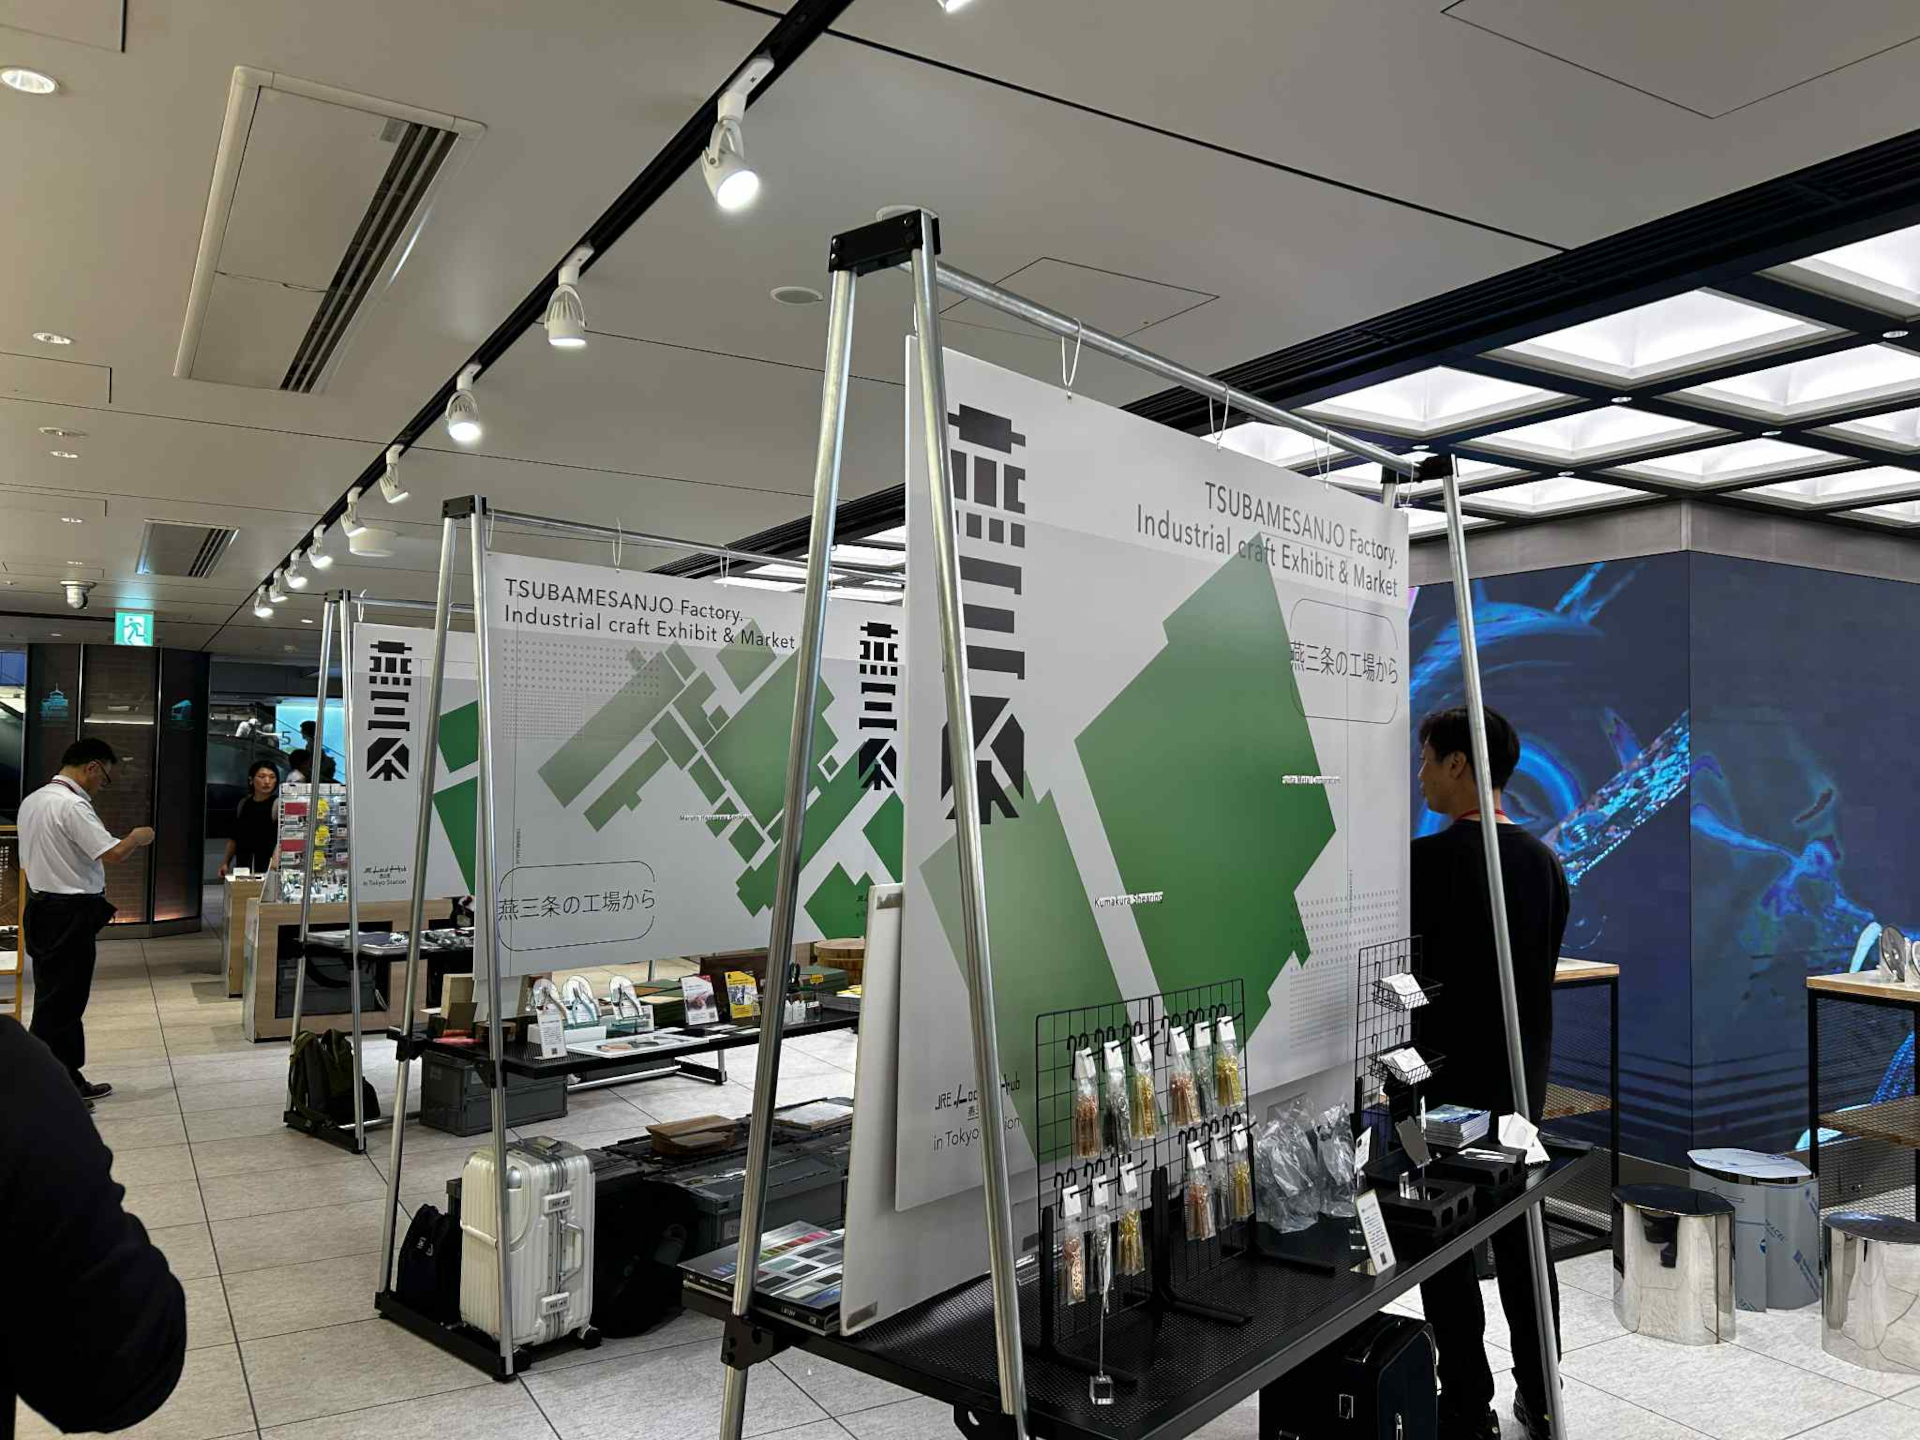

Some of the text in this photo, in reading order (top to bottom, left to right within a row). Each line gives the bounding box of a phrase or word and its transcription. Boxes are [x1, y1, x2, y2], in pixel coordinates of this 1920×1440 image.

[1205, 481, 1398, 570] TSUBAMESANJO Factory.
[1137, 504, 1398, 598] Industrial craft Exhibit & Market
[505, 578, 743, 625] TSUBAMESANJO Factory.
[505, 604, 796, 649] Industrial craft Exhibit & Market
[1290, 640, 1399, 684] 燕三条の工場から
[498, 889, 656, 921] 燕三条の工場から
[933, 1127, 980, 1151] in Tokyo
